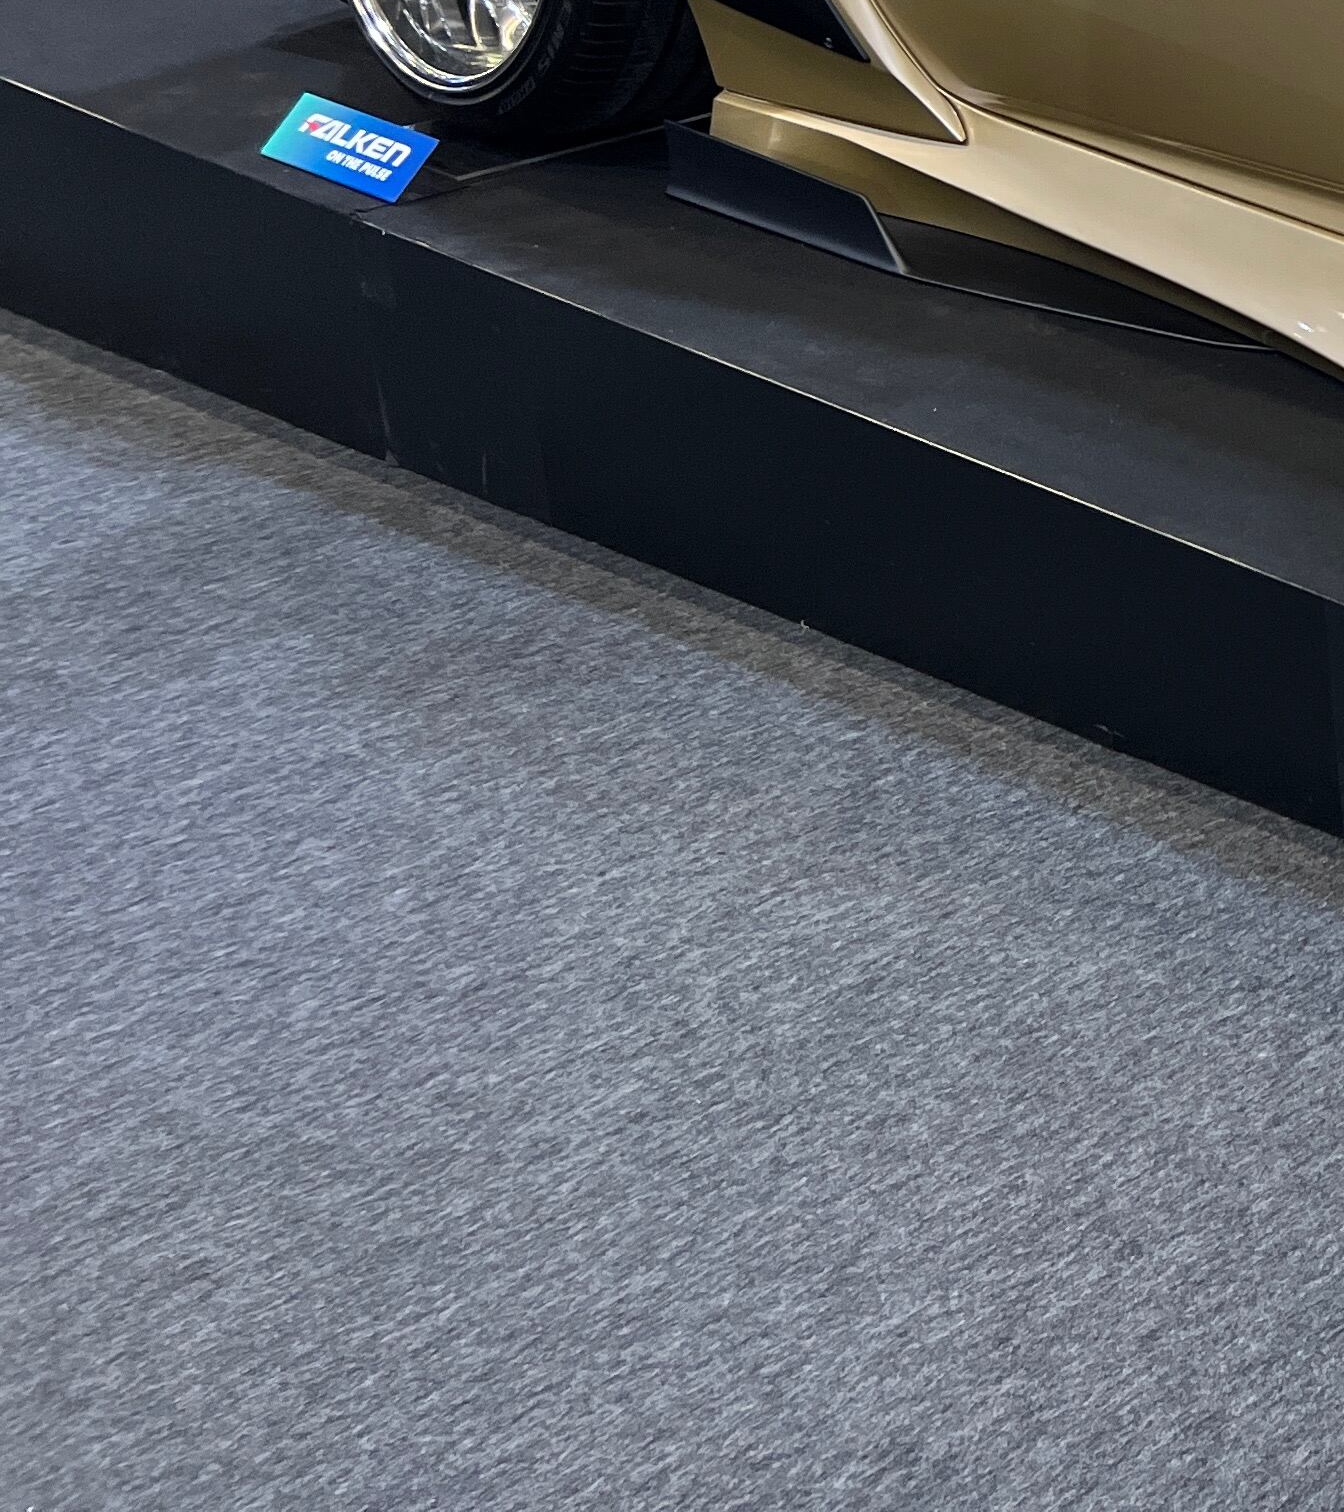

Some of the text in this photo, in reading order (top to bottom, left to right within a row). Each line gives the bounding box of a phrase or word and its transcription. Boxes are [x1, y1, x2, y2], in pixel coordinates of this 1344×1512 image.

[298, 113, 412, 168] FALKEN
[325, 149, 393, 182] ON THE PULSE
